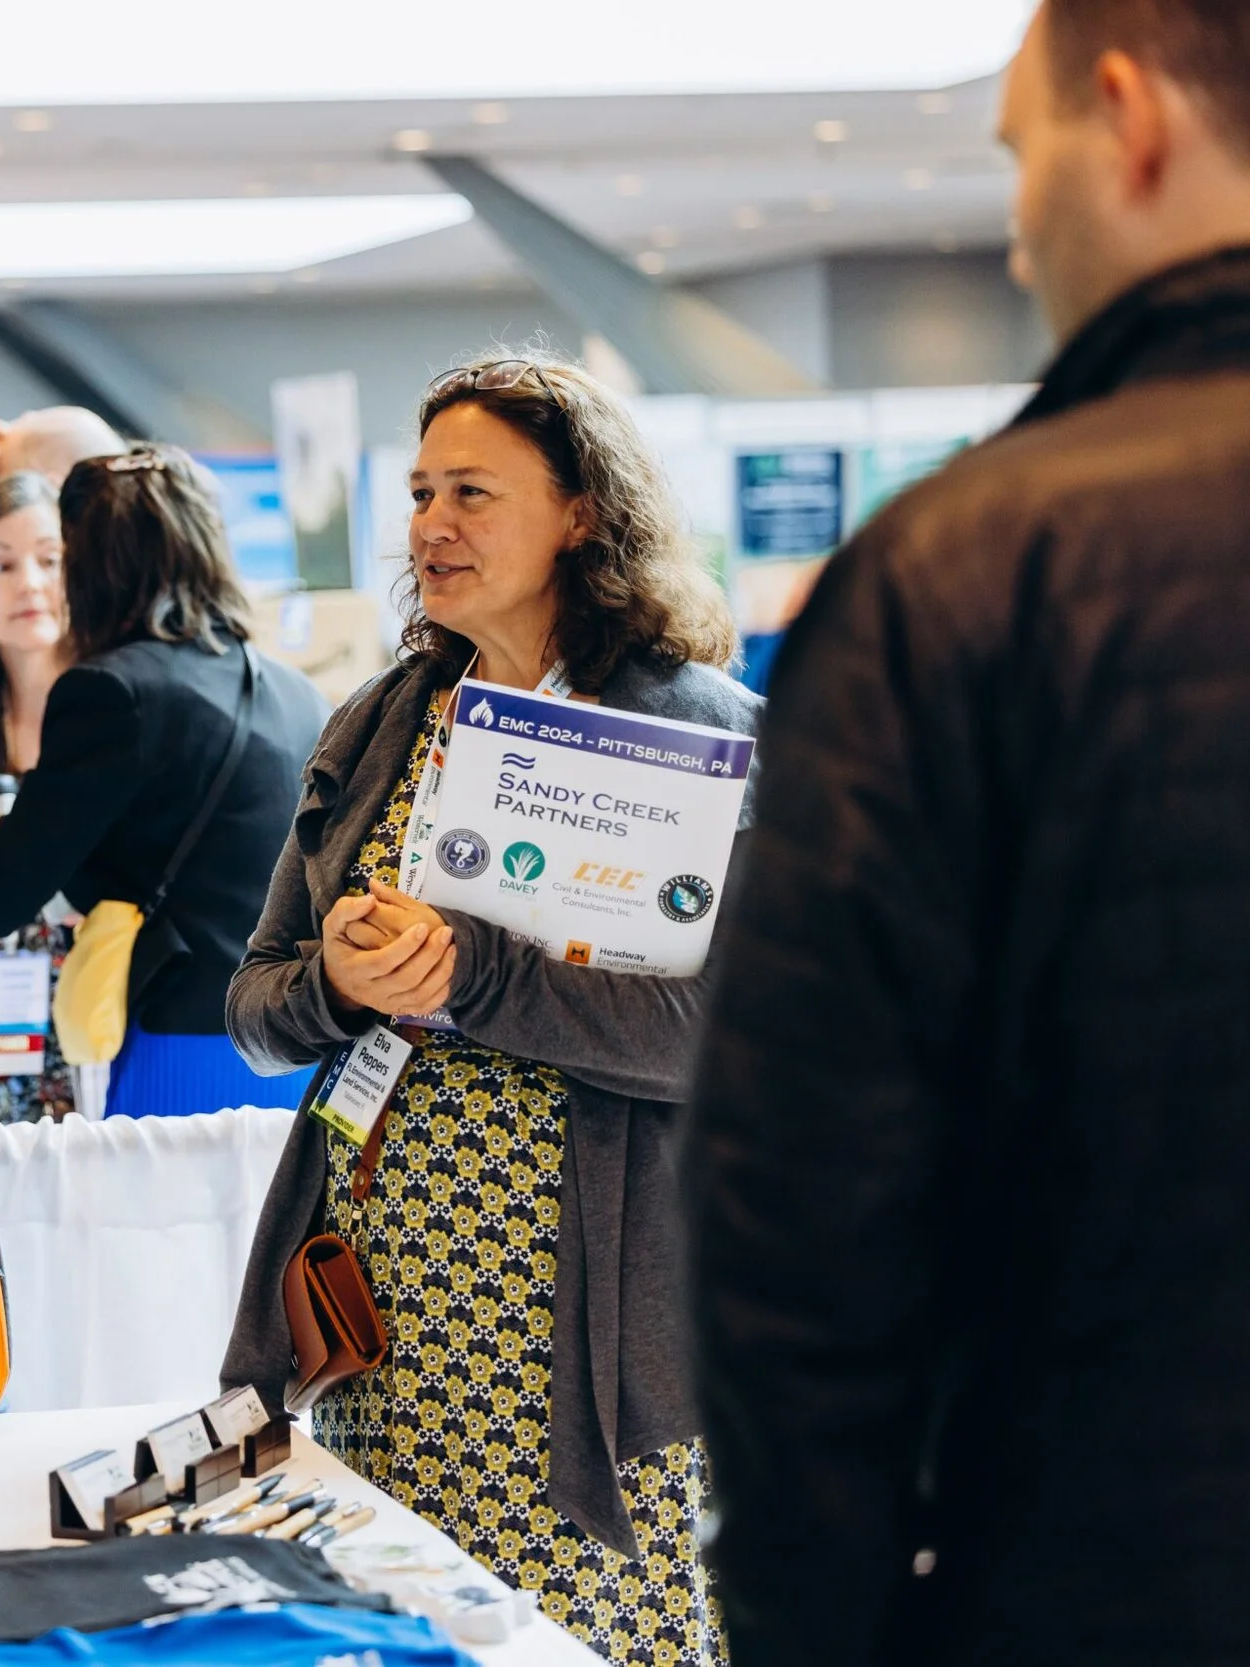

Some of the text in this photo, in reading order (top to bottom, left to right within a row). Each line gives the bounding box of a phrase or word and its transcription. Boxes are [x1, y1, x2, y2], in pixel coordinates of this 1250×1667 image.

[499, 716, 535, 735] EMC
[538, 724, 583, 745] 2024
[598, 736, 706, 772] PITTSBURGH,
[711, 760, 732, 774] PA
[498, 772, 681, 826] SANDY CREEK
[493, 793, 628, 837] PARTNERS
[499, 879, 539, 896] DAVEY
[552, 882, 646, 908] Civil & Environmental
[661, 875, 713, 896] WILLIAMS
[597, 958, 669, 975] Environmental
[599, 947, 646, 963] Headway
[374, 1033, 391, 1053] Elva
[358, 1046, 389, 1076] Peppers
